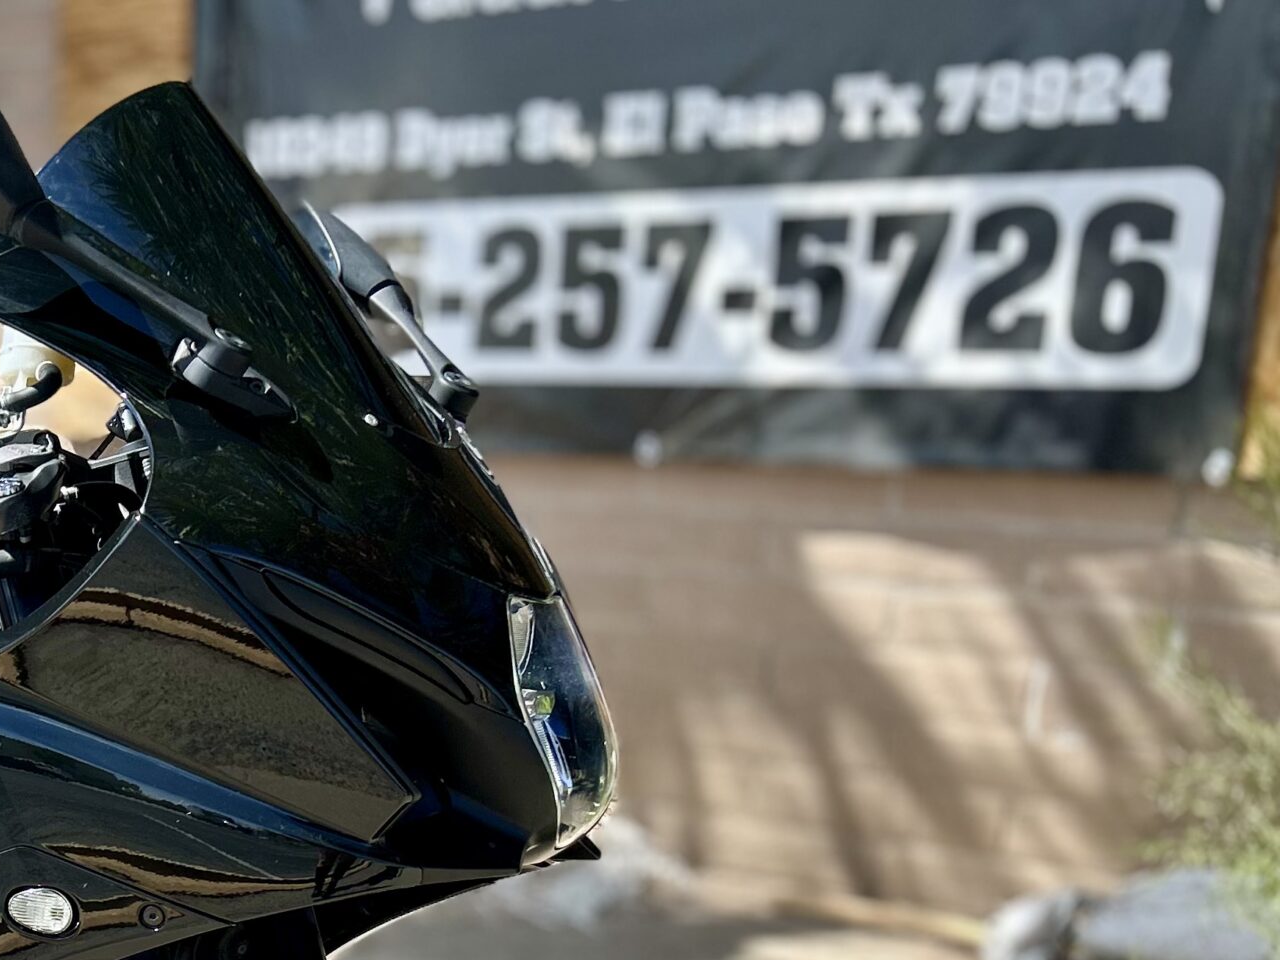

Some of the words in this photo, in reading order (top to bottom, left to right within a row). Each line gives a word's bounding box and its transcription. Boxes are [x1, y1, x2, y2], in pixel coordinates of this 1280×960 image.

[673, 86, 824, 152] Paso
[833, 71, 924, 142] Tx
[935, 49, 1172, 135] 79924
